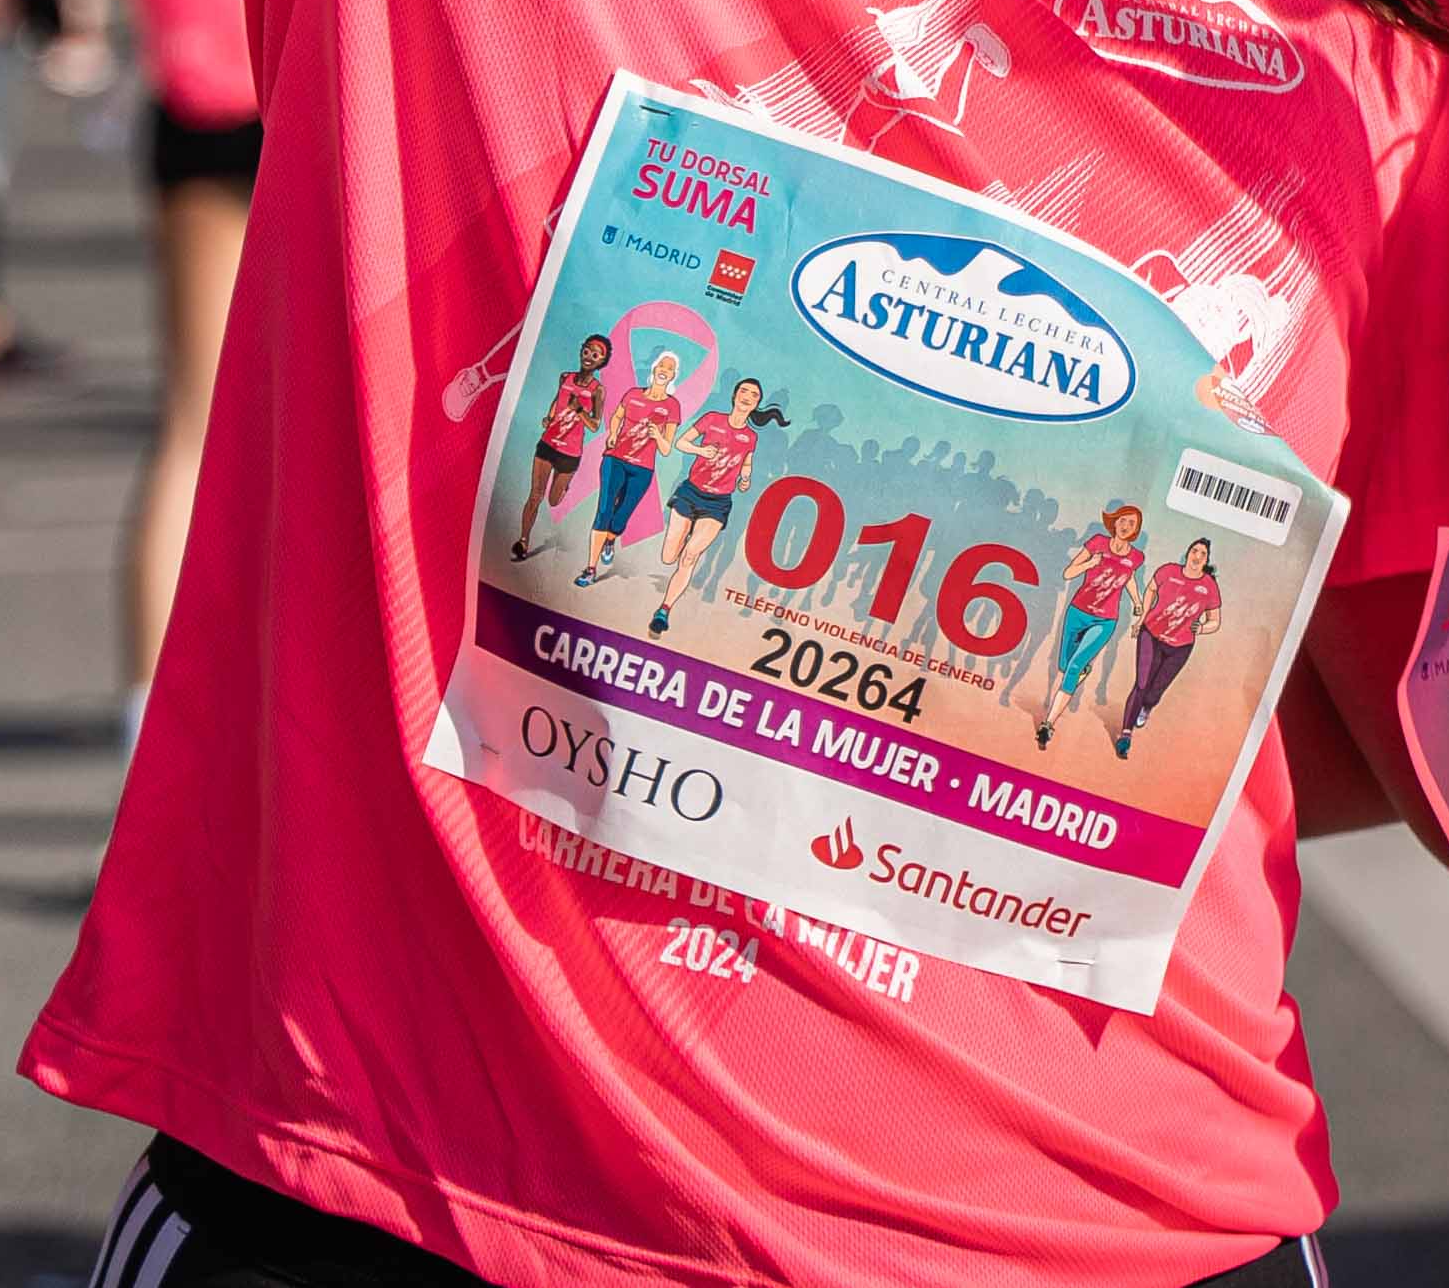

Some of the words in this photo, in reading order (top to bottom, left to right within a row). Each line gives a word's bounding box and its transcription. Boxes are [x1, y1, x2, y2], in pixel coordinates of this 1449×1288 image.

[1206, 8, 1281, 44] LECHERA
[632, 163, 757, 235] SUMA
[647, 138, 677, 163] TU
[681, 148, 770, 197] DORSAL
[625, 234, 702, 271] MADRID
[811, 259, 1102, 405] ASTURIANA
[882, 268, 988, 315] CENTRAL
[998, 307, 1105, 355] LECHERA
[743, 475, 1040, 658] 016
[724, 587, 810, 627] TELÉFONO
[813, 620, 899, 659] VIOLENCIA
[902, 649, 925, 666] DE
[927, 654, 995, 692] GÉNERO
[750, 627, 927, 724] 20264
[521, 705, 724, 822] OYSHO
[534, 625, 687, 708] CARRERA
[697, 680, 752, 729] DE
[755, 700, 802, 747] LA
[811, 719, 940, 793] MUJER
[967, 772, 1119, 852] MADRID
[868, 843, 1092, 938] Santander
[659, 917, 761, 985] 2024
